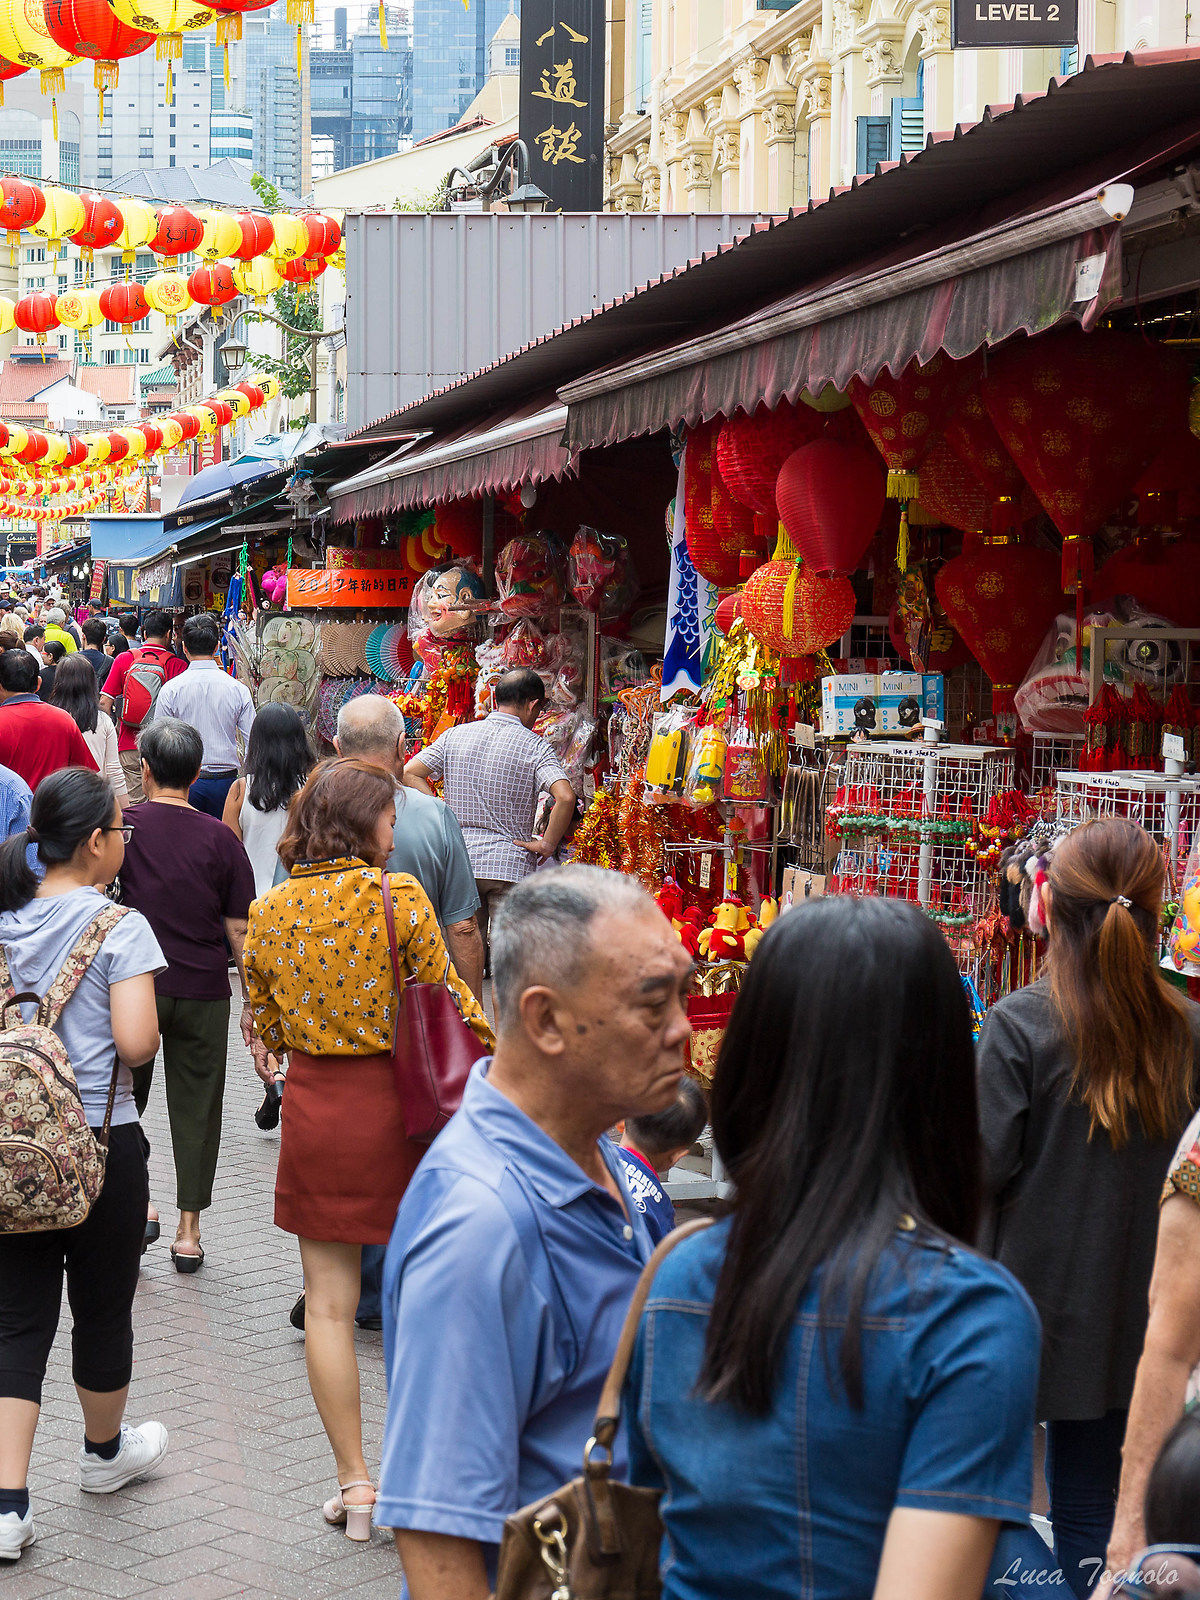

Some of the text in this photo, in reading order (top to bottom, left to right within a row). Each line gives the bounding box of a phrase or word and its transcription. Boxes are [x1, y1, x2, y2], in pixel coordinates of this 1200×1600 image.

[975, 3, 1060, 21] LEVEL 2
[838, 682, 859, 692] MINI
[883, 682, 903, 691] MINI
